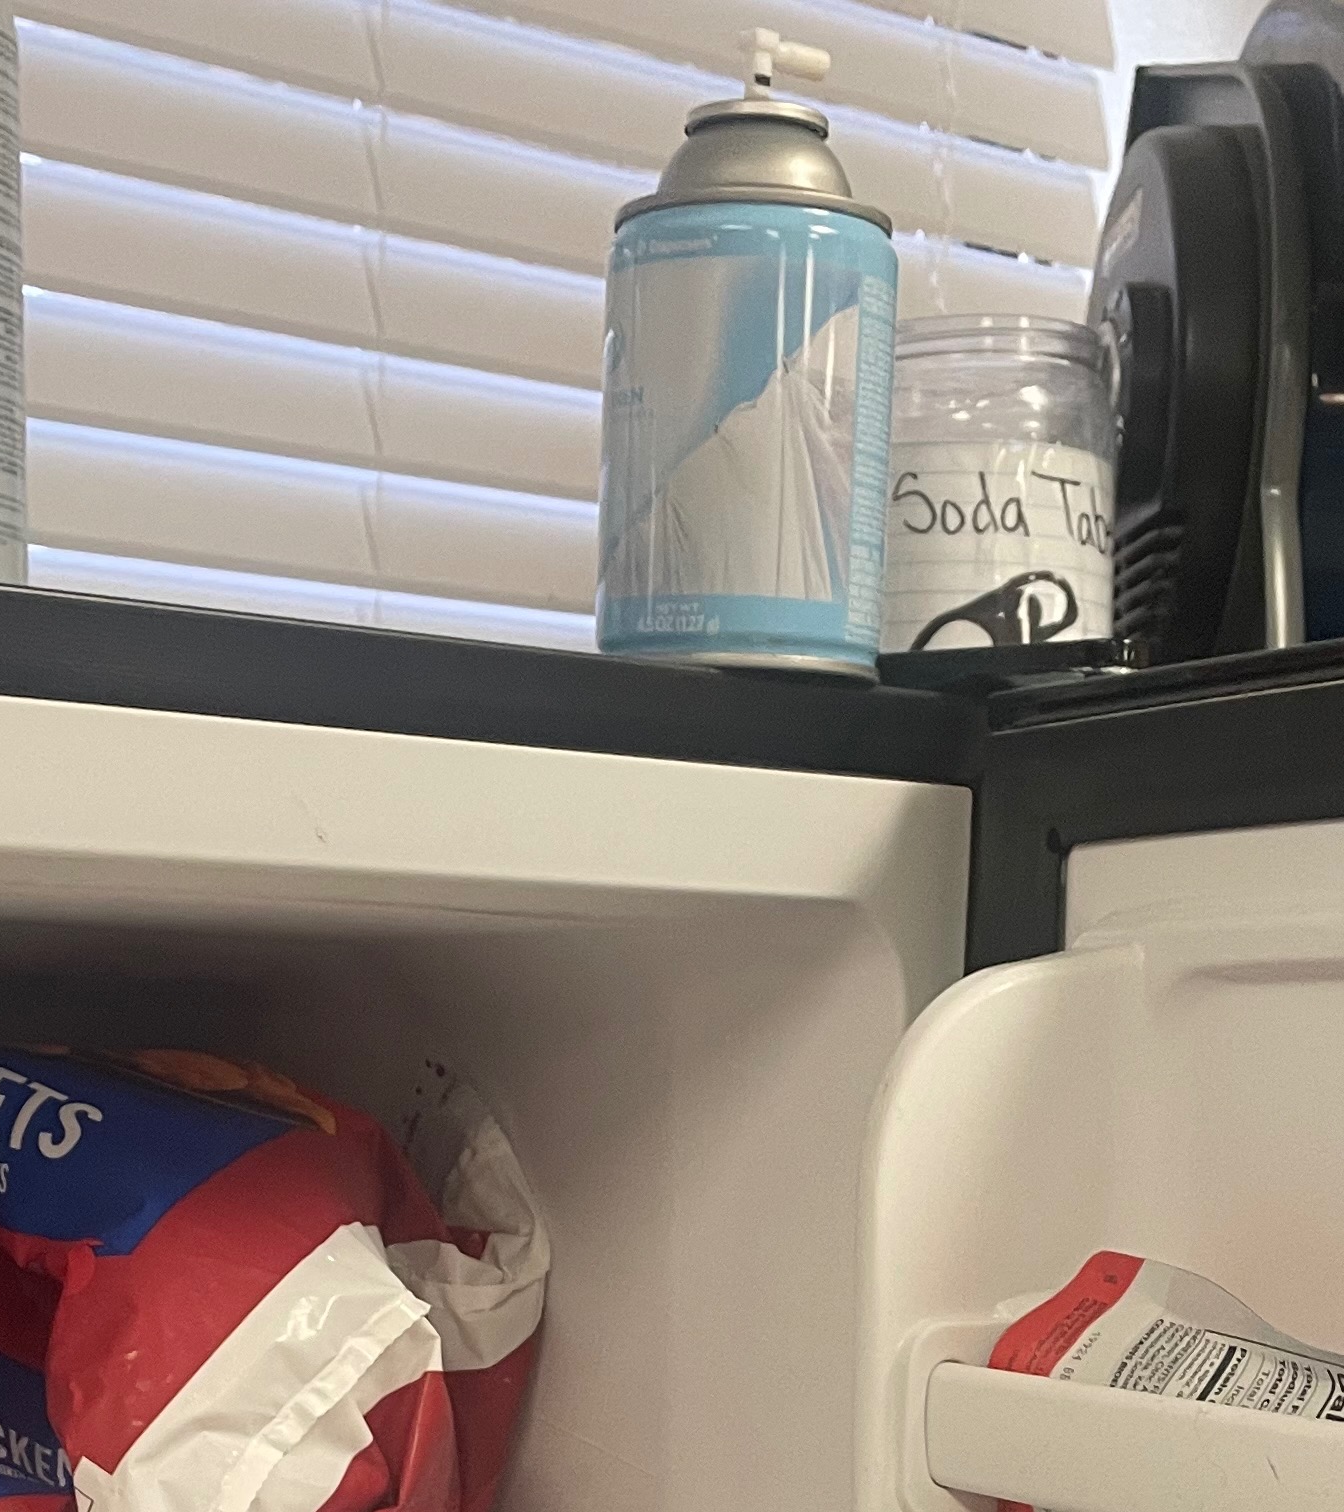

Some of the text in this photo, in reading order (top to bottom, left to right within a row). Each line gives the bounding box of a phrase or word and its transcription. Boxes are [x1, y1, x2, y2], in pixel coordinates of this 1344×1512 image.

[891, 470, 1112, 555] Soda Tab
[1214, 1347, 1247, 1396] Protein
[1247, 1370, 1271, 1403] Total
[1268, 1360, 1287, 1395] Total
[1297, 1364, 1313, 1402] Total
